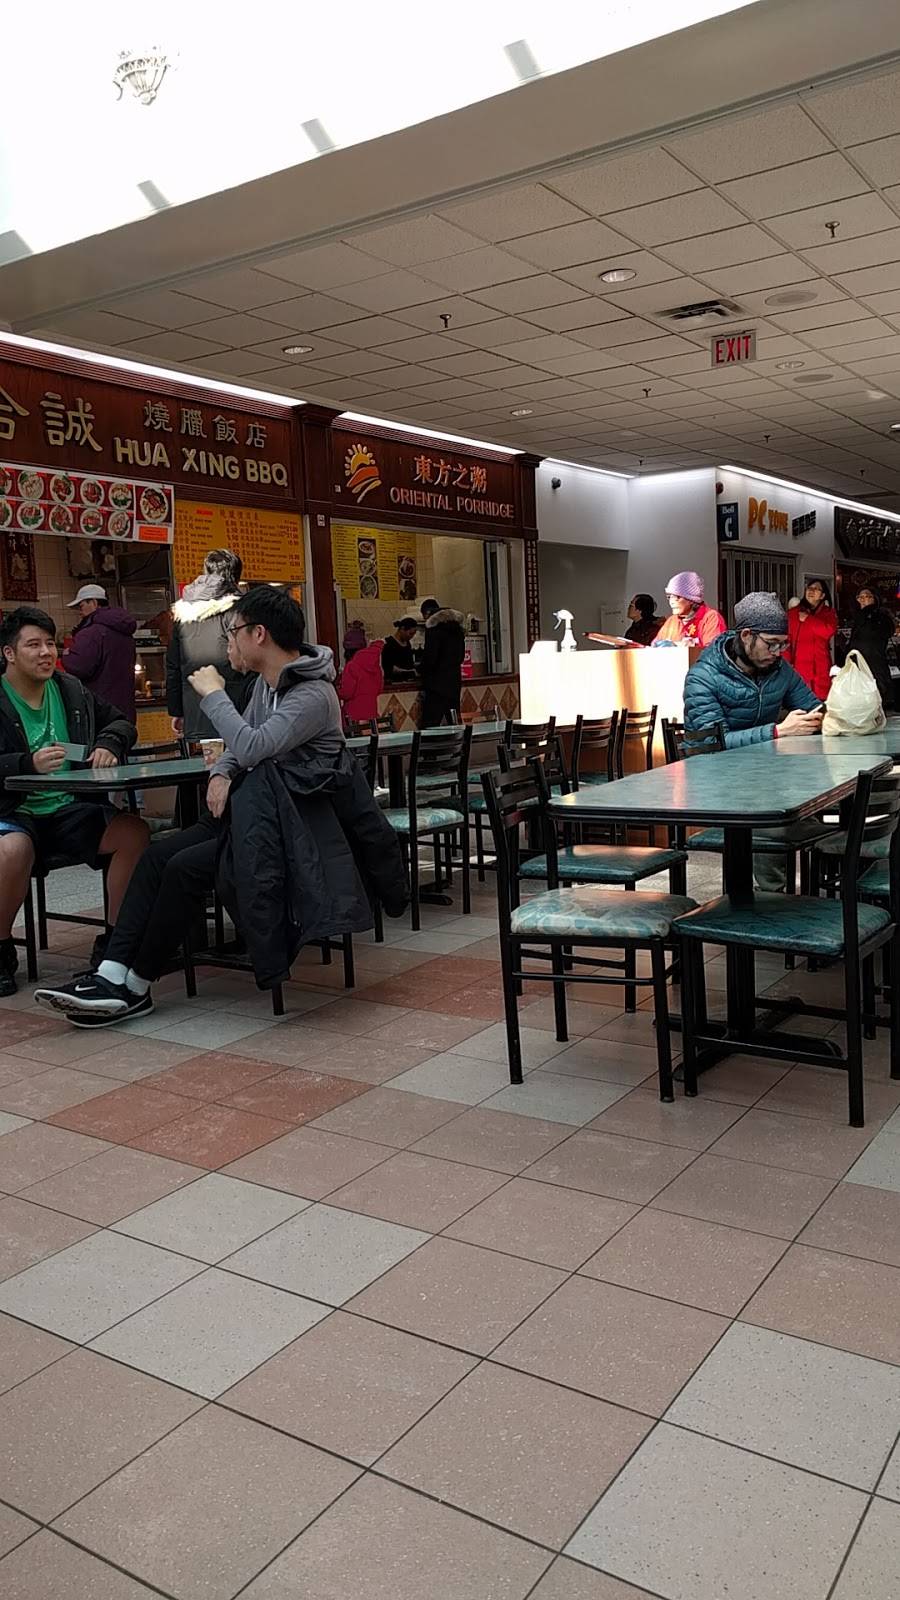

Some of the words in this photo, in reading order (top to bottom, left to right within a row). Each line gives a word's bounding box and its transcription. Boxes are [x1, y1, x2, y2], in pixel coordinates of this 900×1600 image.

[715, 335, 752, 364] EXIT
[114, 437, 170, 468] HUA
[182, 447, 240, 480] XING
[244, 458, 288, 487] BBQ
[412, 454, 488, 494] 東方之粥
[389, 487, 453, 511] ORIENTAL
[456, 496, 515, 519] PORRIDGE
[722, 505, 735, 514] Bell
[748, 496, 768, 529] PC
